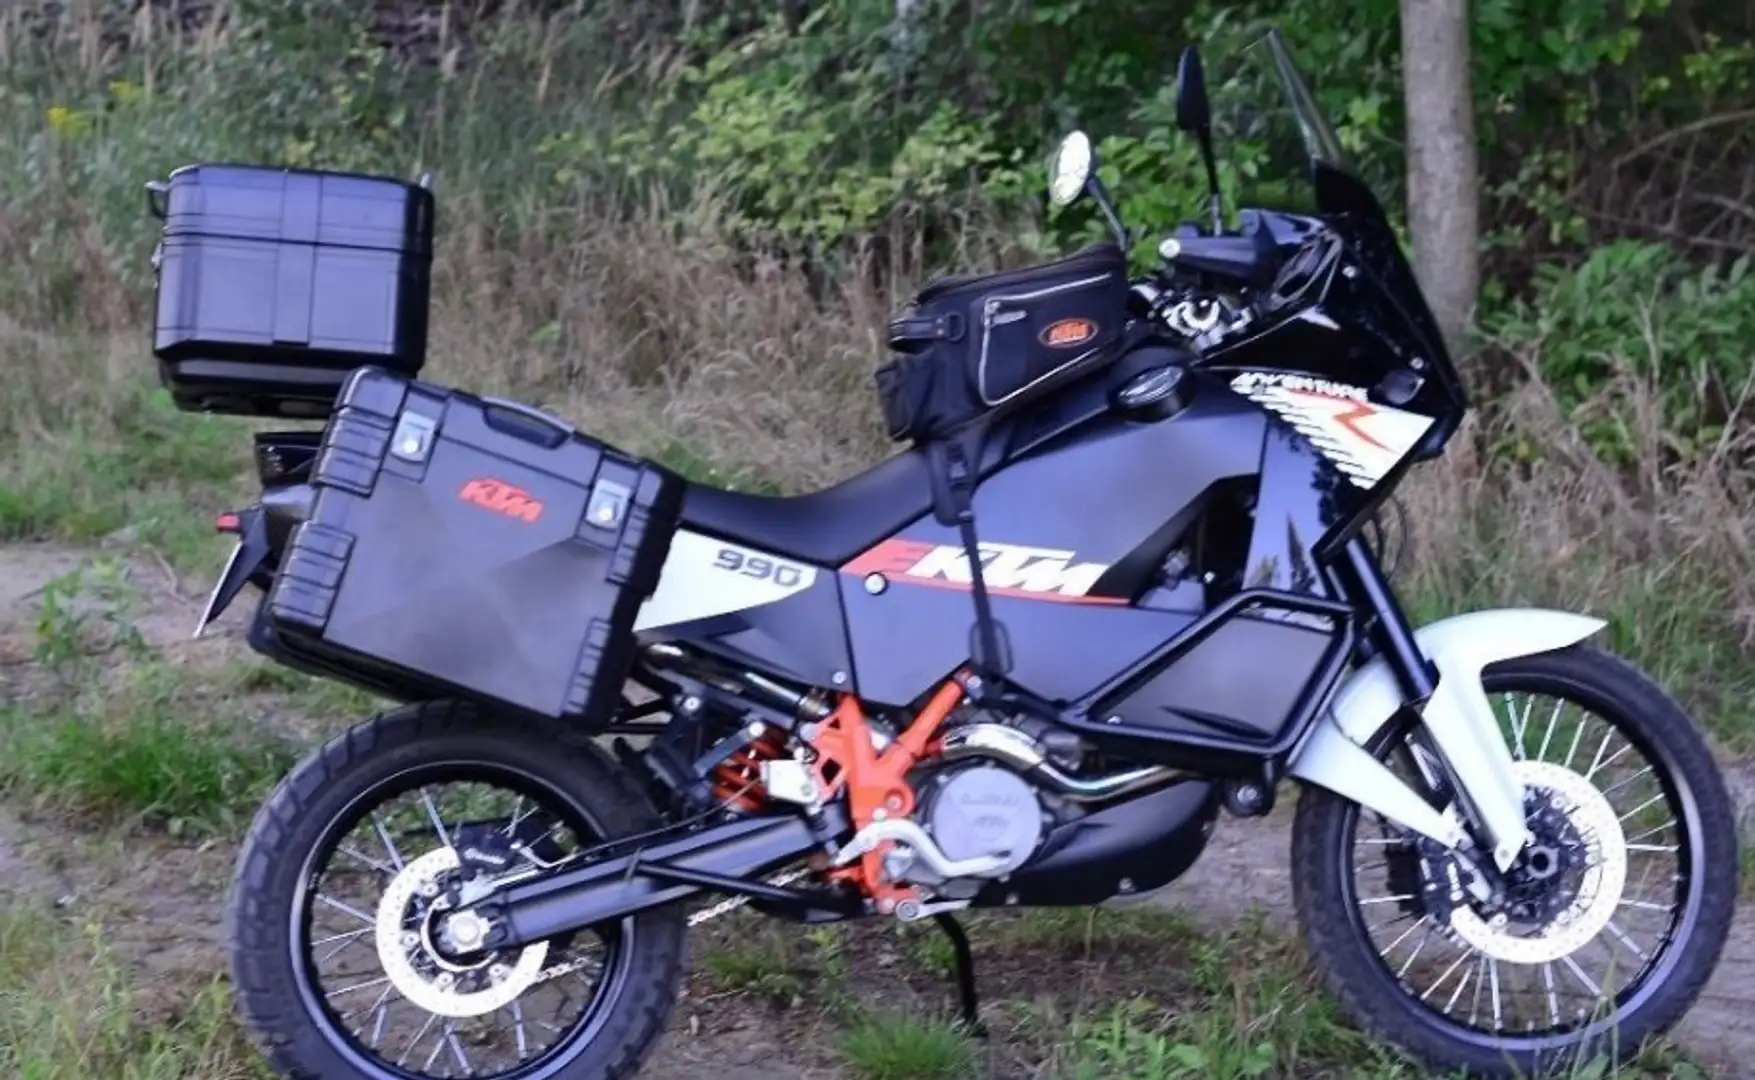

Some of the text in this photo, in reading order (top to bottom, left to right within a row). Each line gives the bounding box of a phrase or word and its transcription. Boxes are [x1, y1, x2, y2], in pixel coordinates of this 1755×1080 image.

[1049, 322, 1087, 344] KTM
[459, 479, 543, 521] KTM
[713, 549, 801, 586] 990
[906, 540, 1108, 597] KTM
